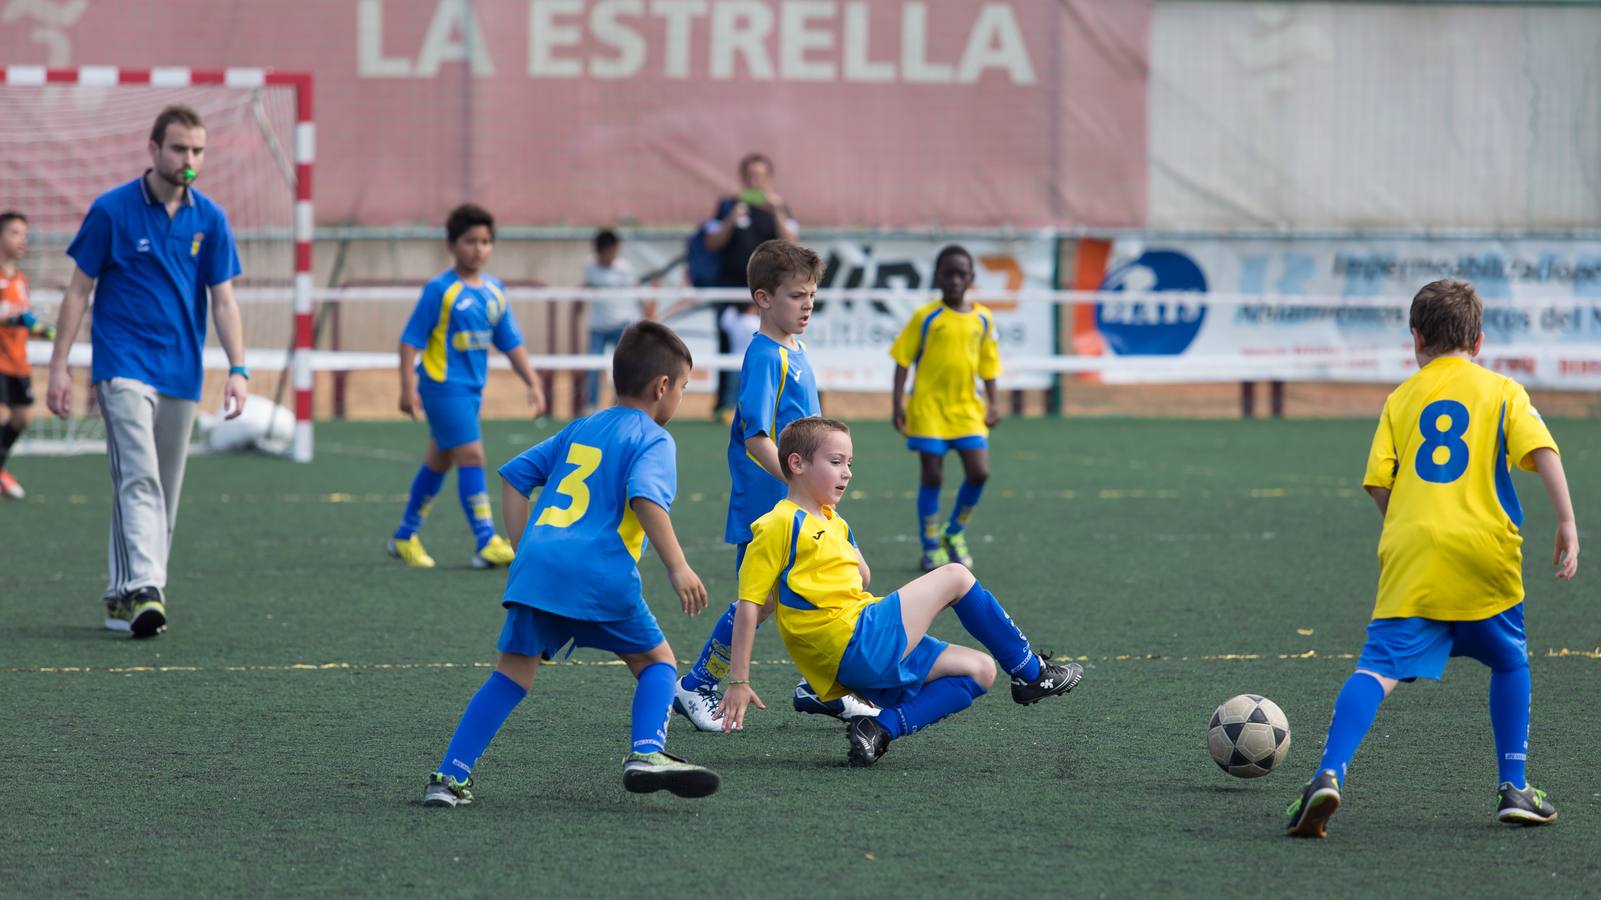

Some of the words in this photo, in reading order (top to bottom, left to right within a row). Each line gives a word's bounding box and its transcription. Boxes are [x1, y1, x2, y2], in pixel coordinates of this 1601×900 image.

[357, 0, 495, 79] LA
[527, 0, 1037, 85] ESTRELLA
[1415, 400, 1470, 483] 8
[534, 442, 602, 528] 3
